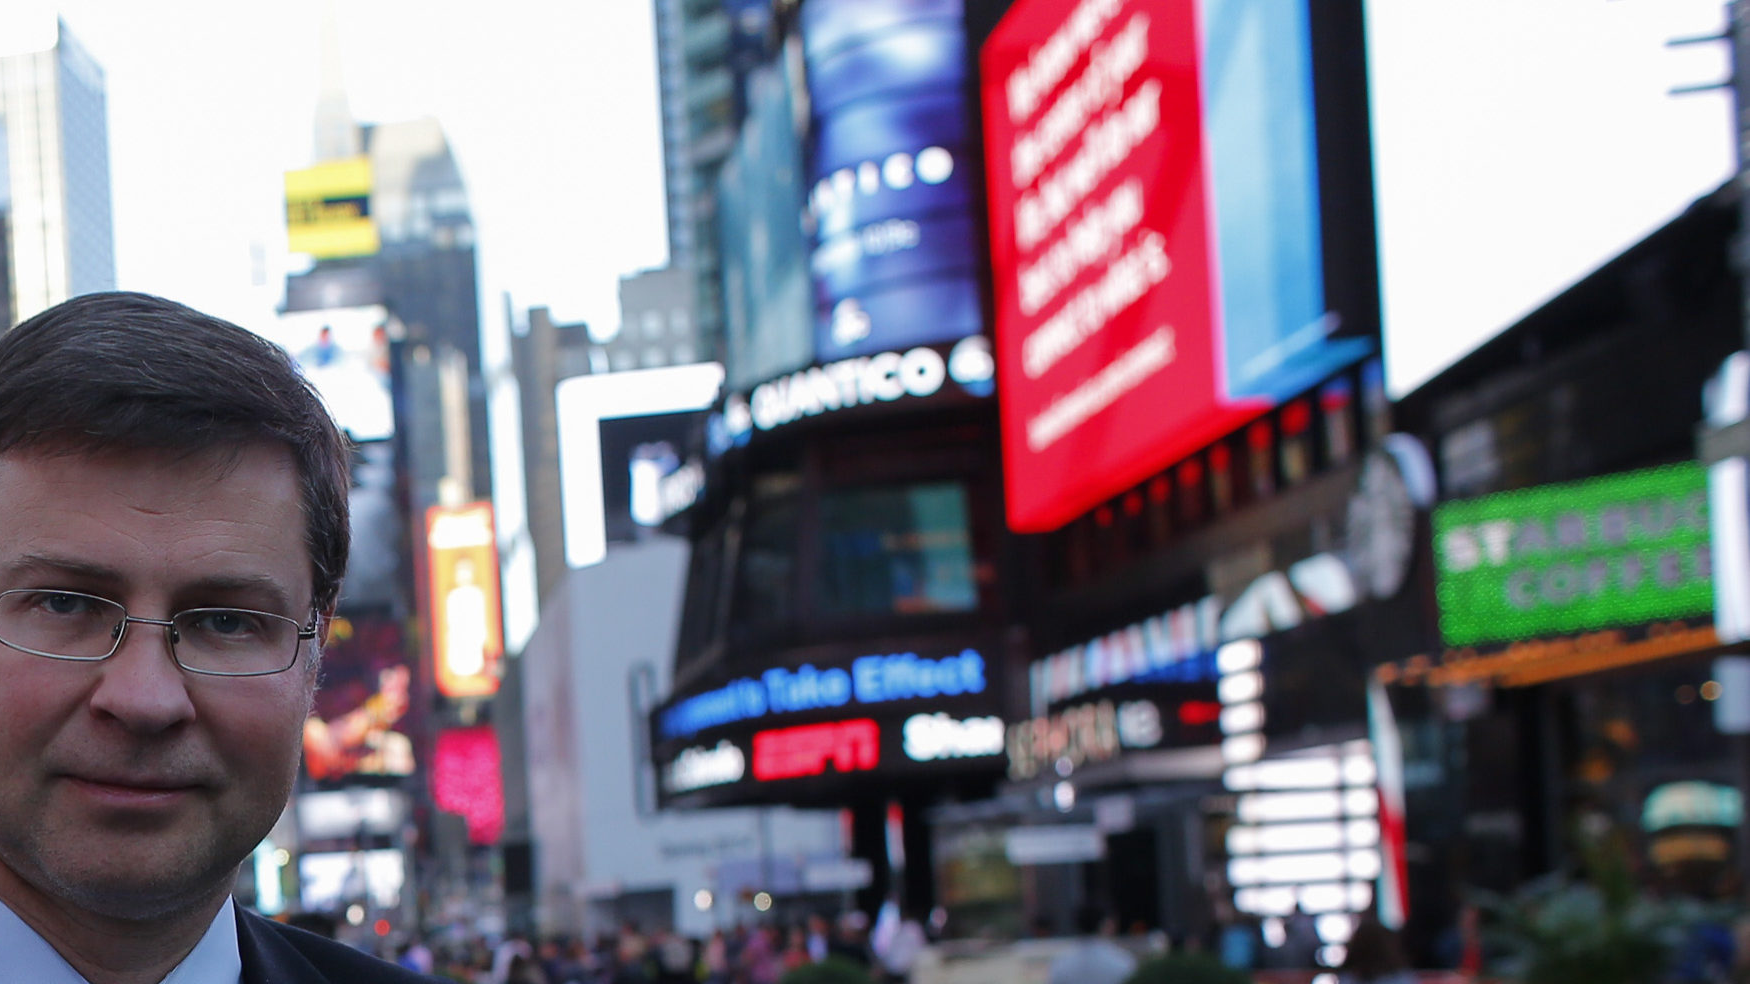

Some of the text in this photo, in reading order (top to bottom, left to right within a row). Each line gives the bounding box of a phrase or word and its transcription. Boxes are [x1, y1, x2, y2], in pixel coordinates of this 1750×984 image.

[1442, 489, 1709, 572] STARBUC
[852, 648, 986, 703] Effect
[752, 718, 880, 782] ESPN
